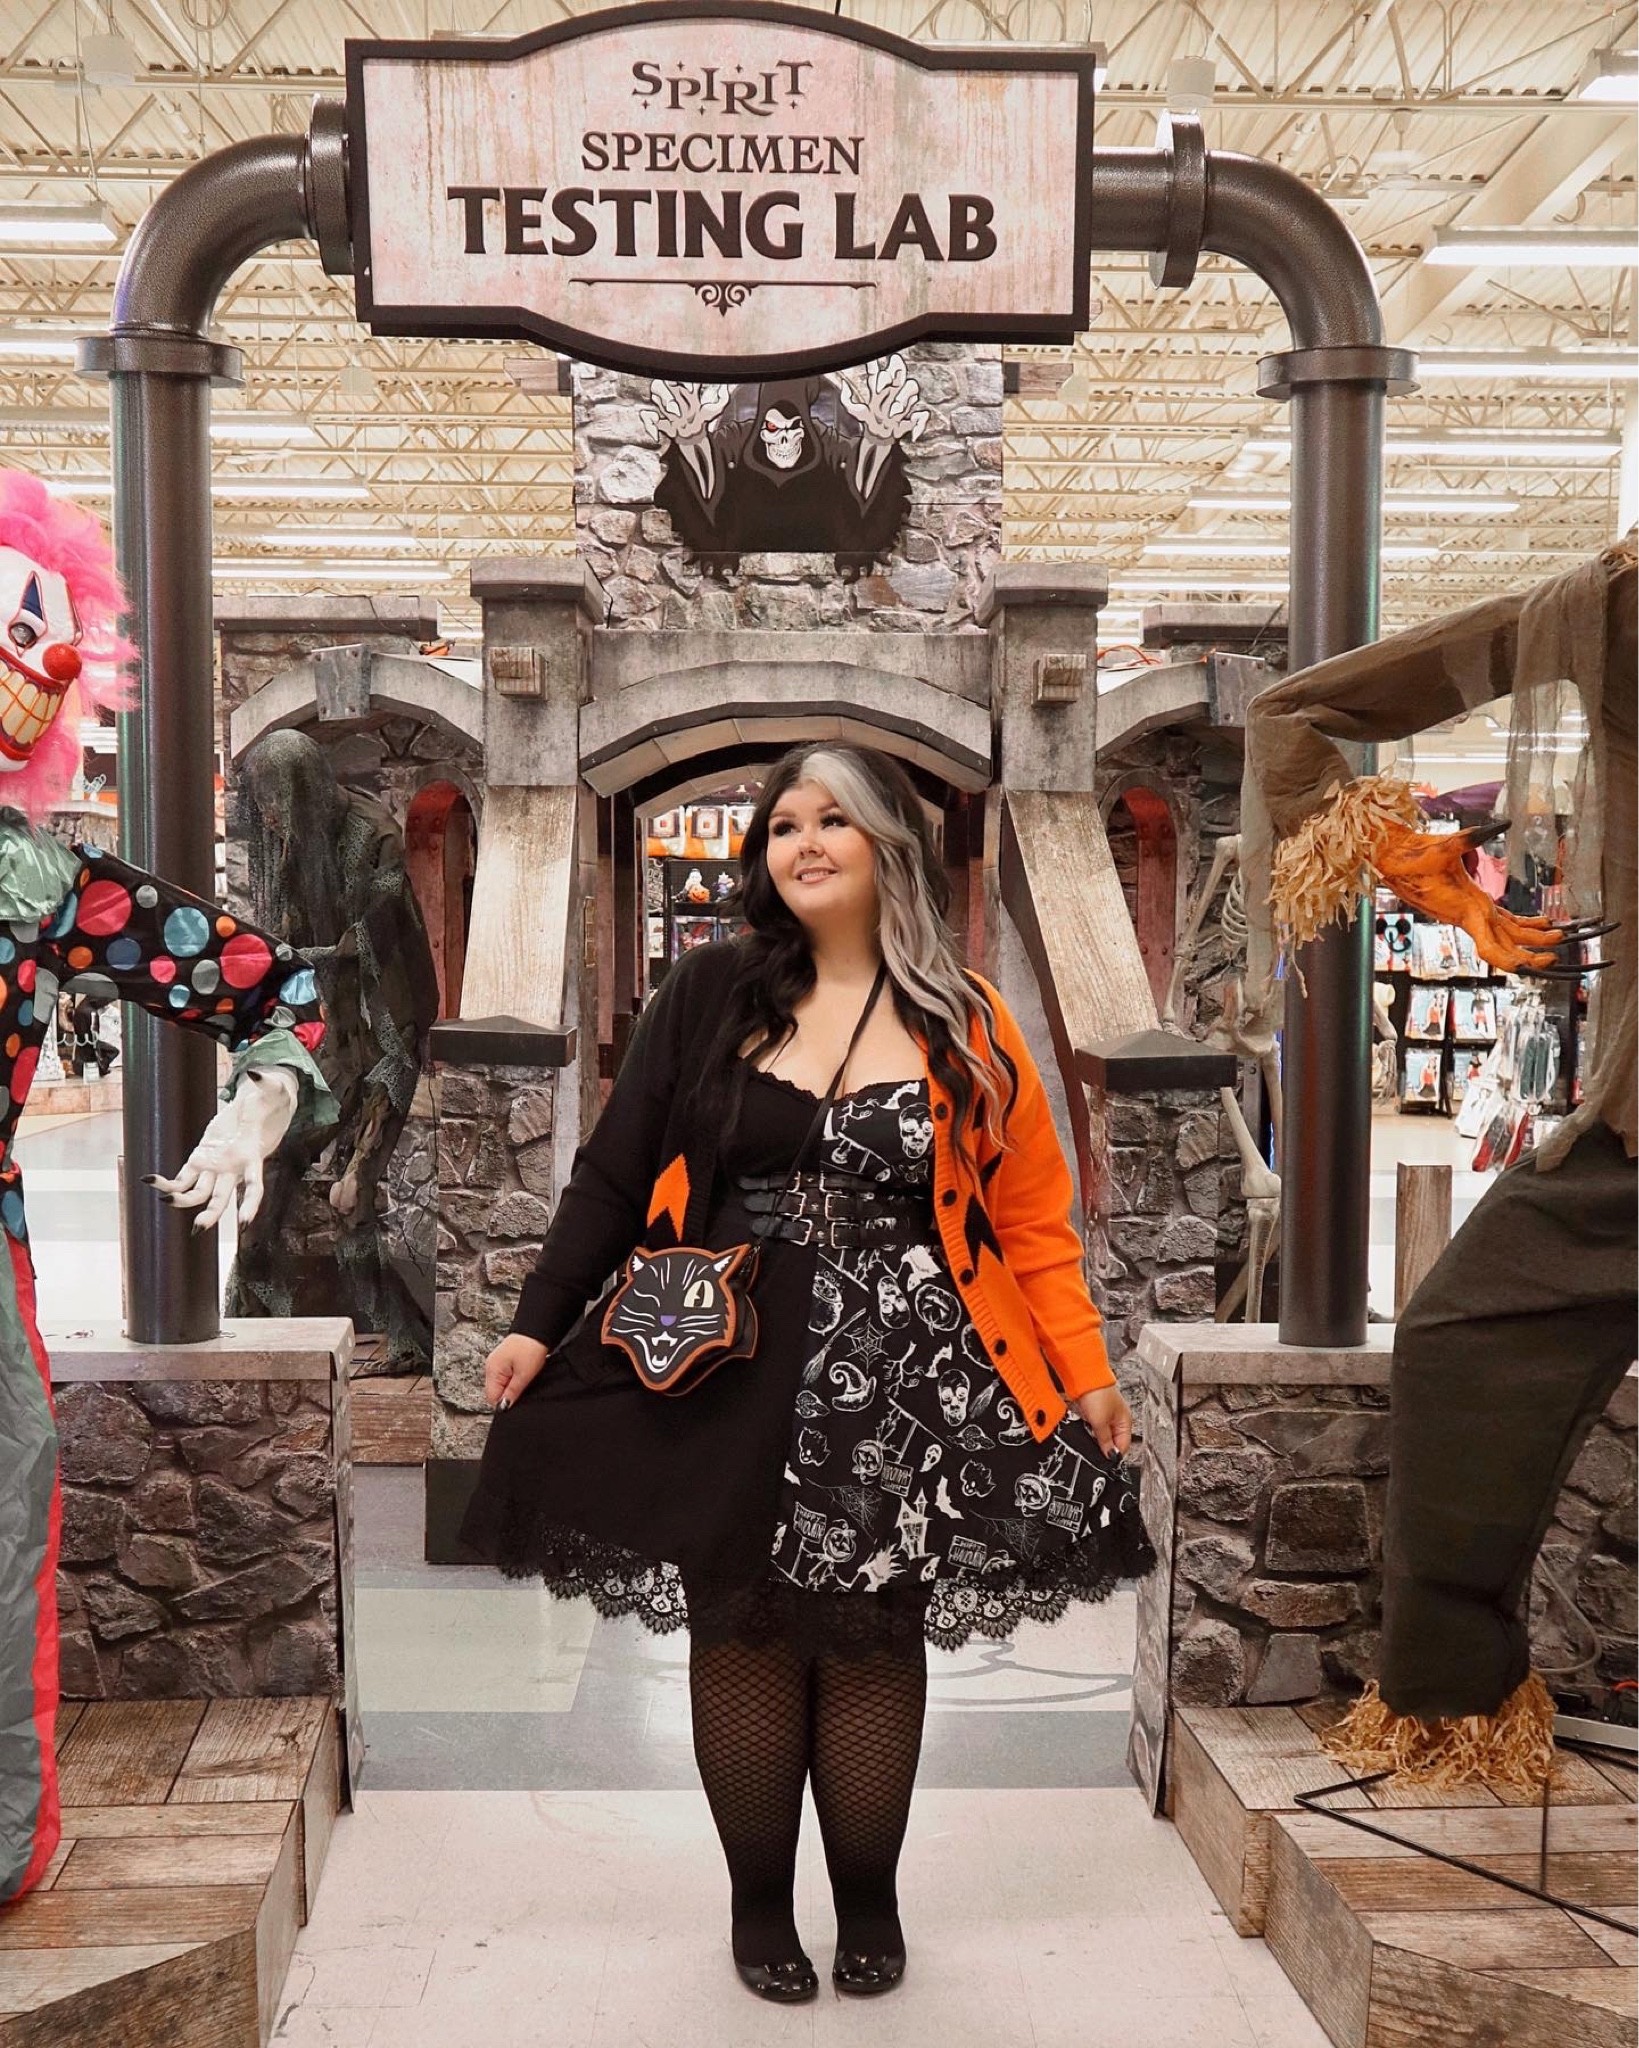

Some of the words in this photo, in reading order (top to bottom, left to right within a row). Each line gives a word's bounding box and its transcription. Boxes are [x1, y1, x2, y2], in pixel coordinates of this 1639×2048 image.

[632, 59, 813, 117] SPIRIT
[581, 131, 865, 175] SPECIMEN
[447, 186, 804, 260] TESTING
[834, 191, 998, 262] LAB
